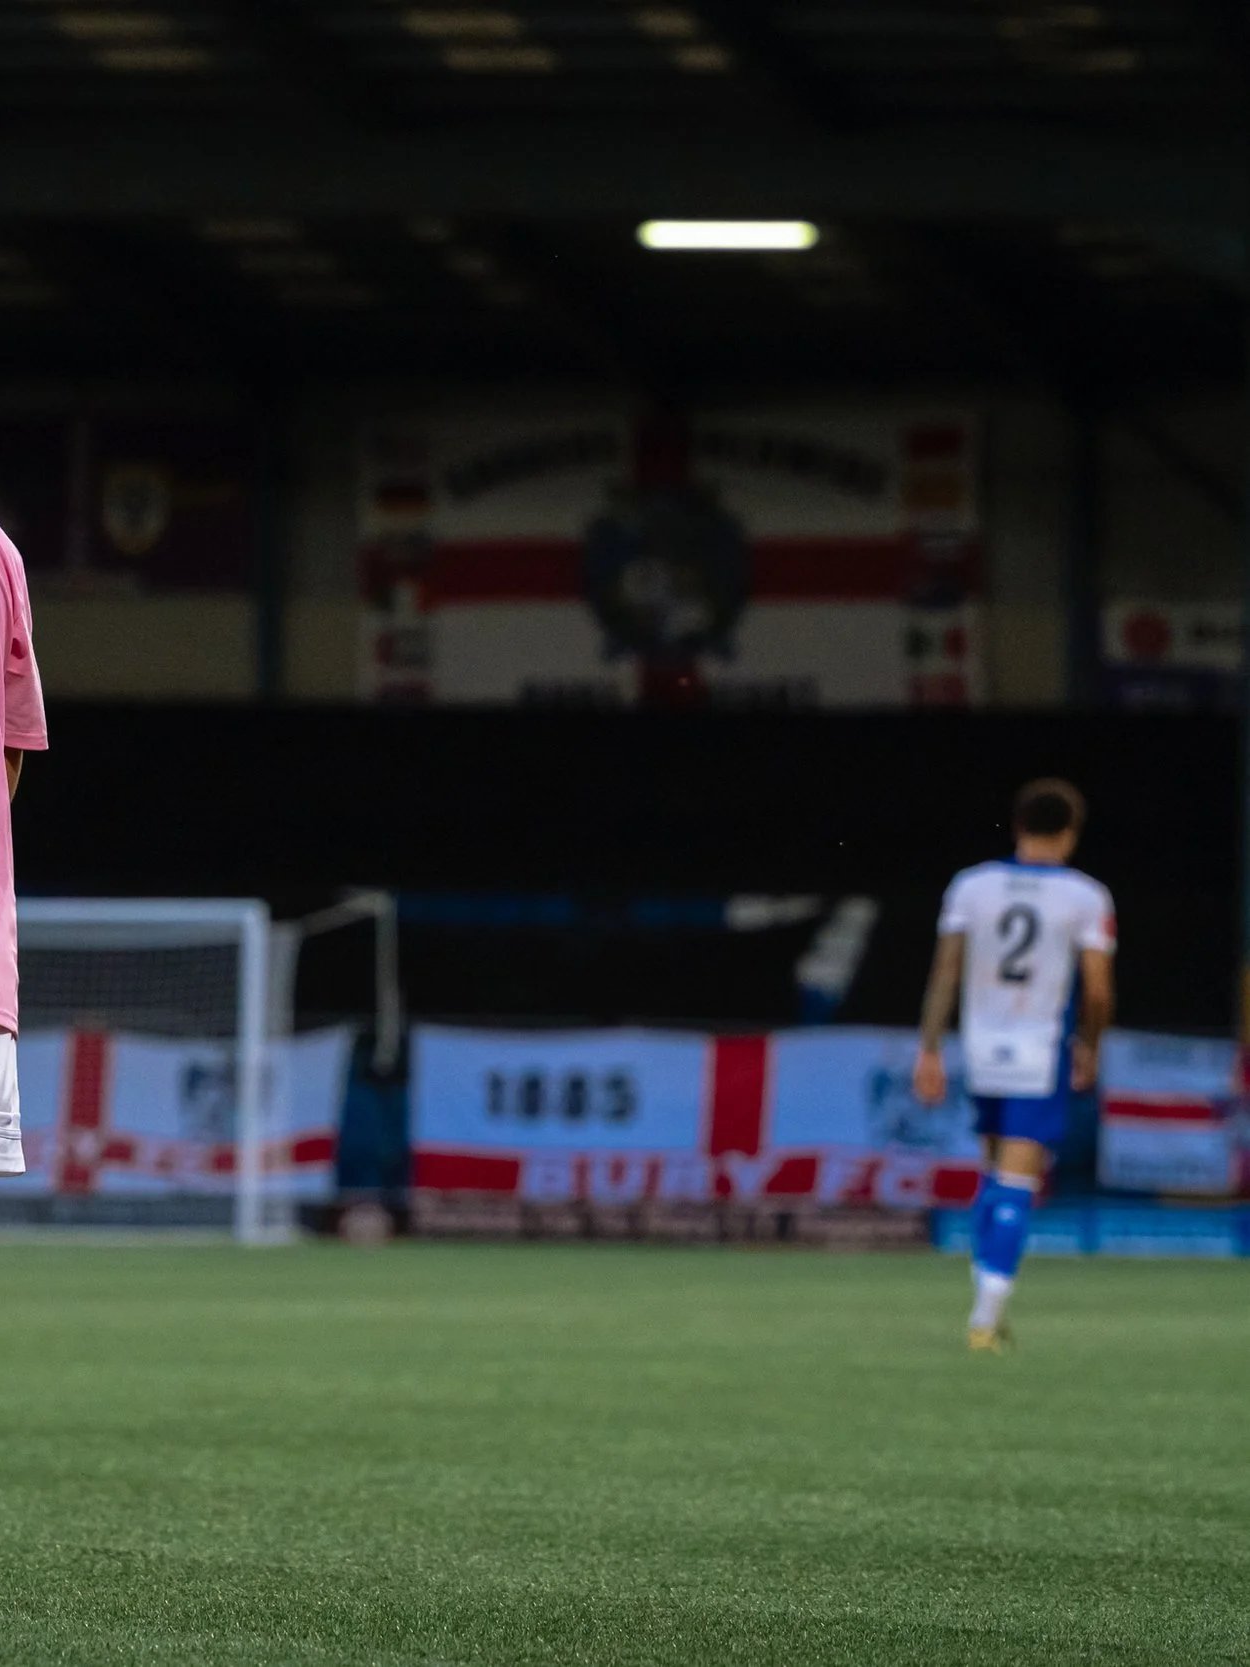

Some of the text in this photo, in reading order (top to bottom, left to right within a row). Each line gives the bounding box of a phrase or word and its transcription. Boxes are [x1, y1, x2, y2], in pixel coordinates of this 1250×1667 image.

[998, 902, 1040, 985] 2
[521, 1149, 934, 1205] BURY FC
